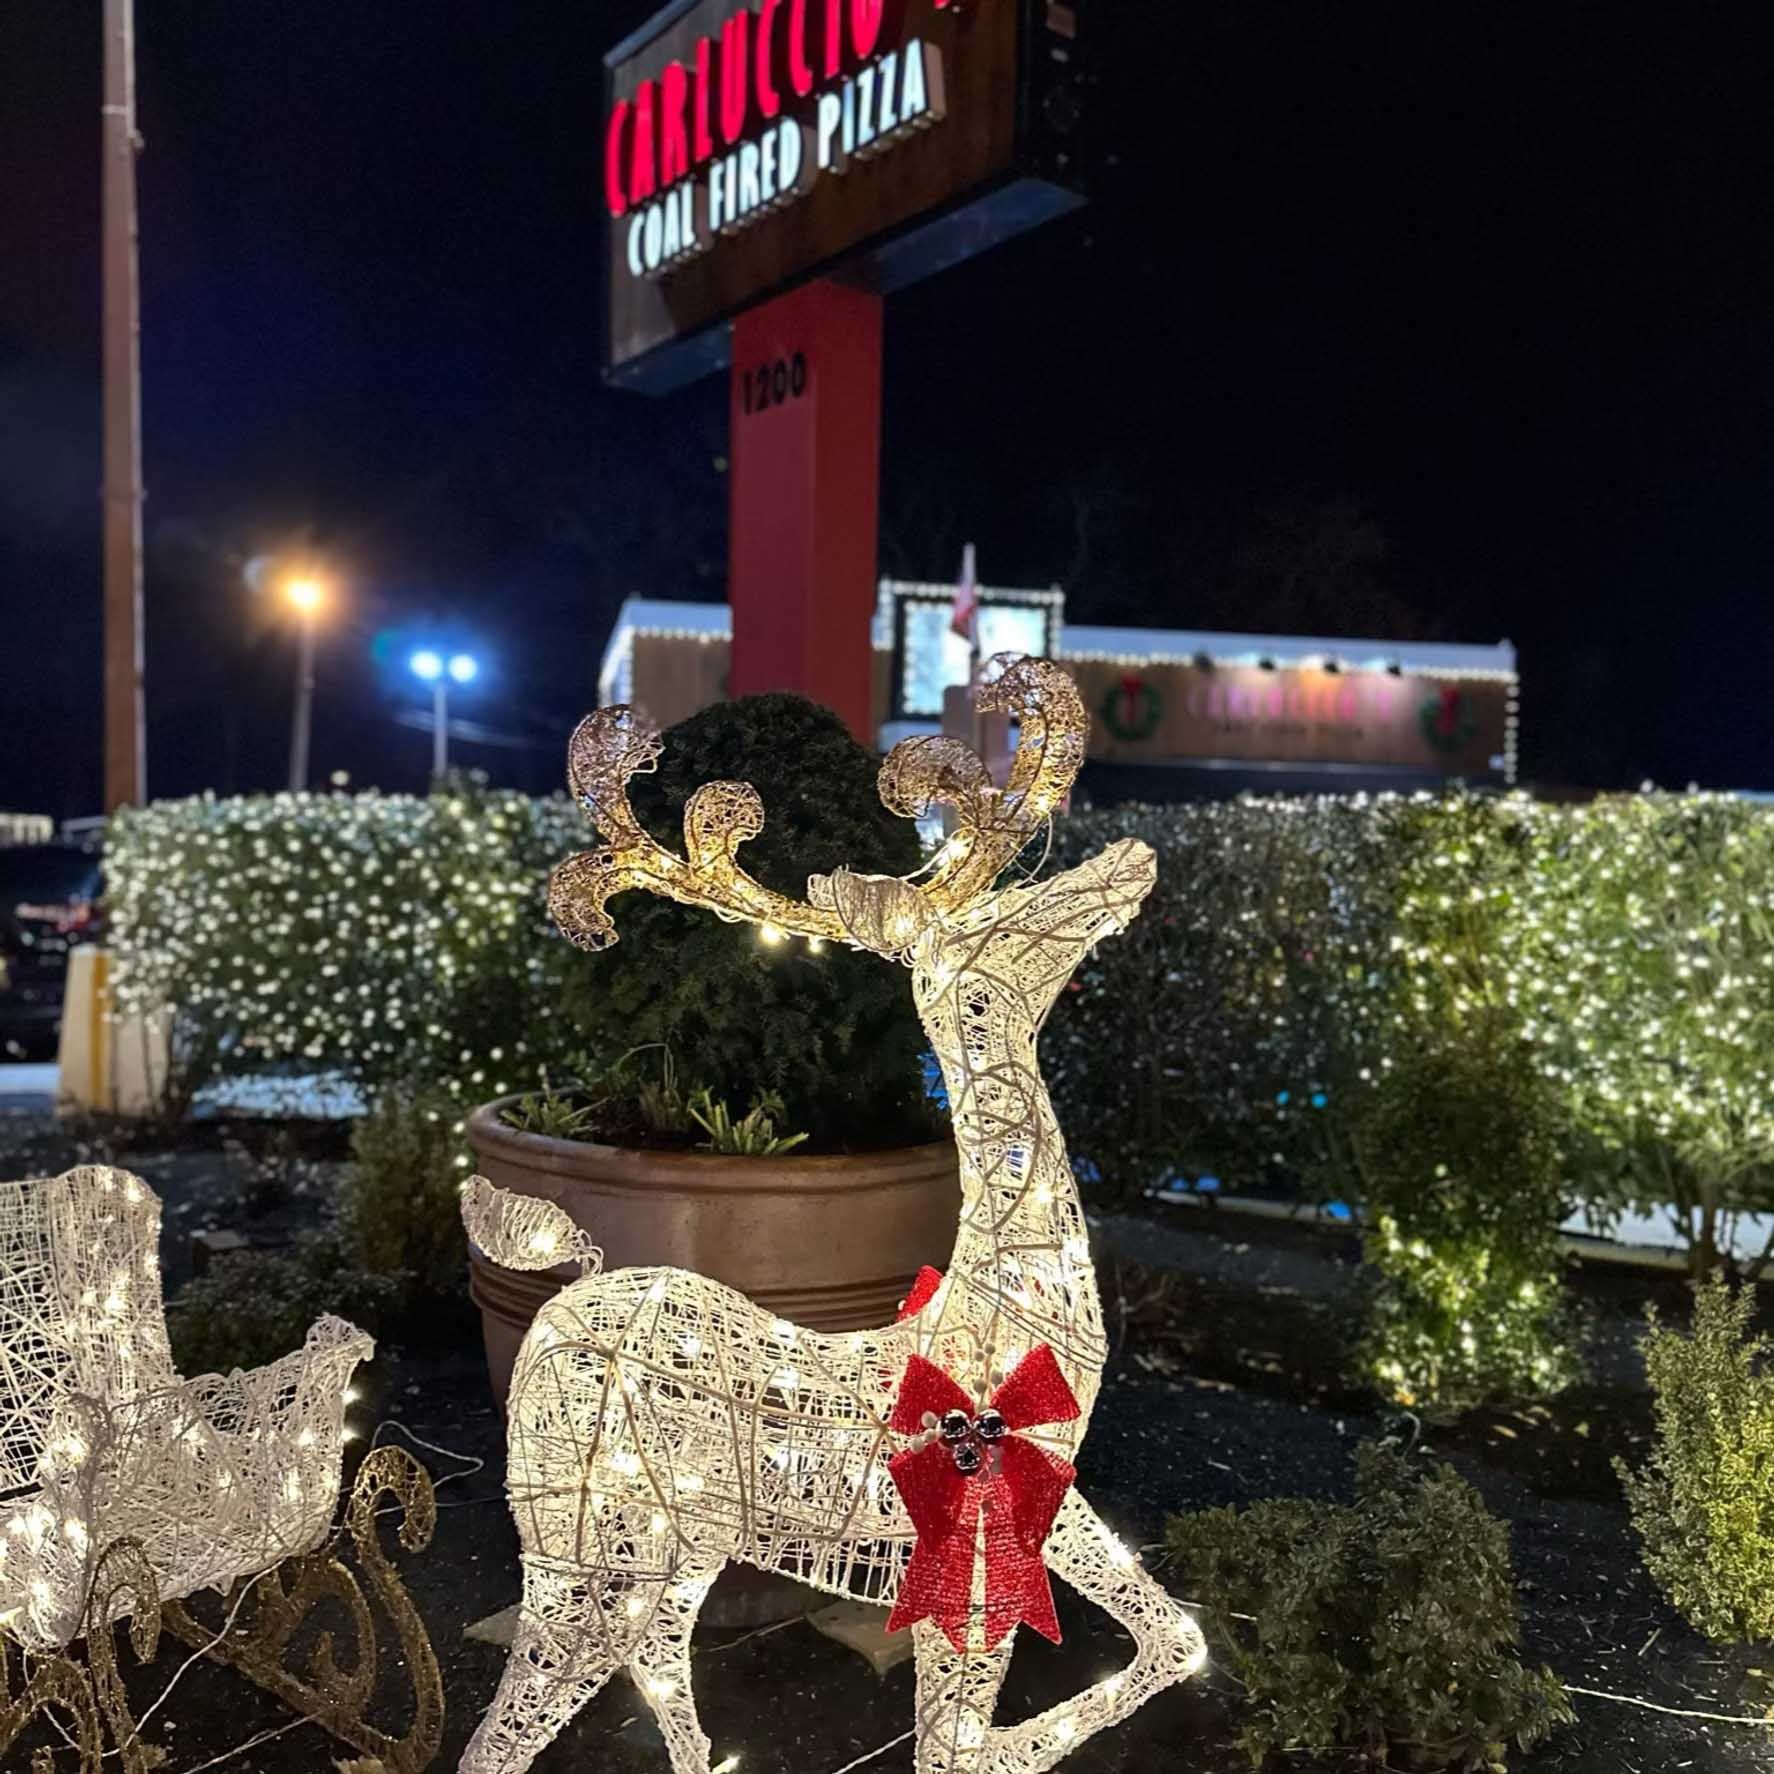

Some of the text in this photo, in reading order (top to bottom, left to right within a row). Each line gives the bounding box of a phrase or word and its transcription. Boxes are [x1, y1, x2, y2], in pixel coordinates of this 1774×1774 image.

[627, 38, 927, 277] COAL FIRED PIZZA
[743, 352, 807, 416] 1200
